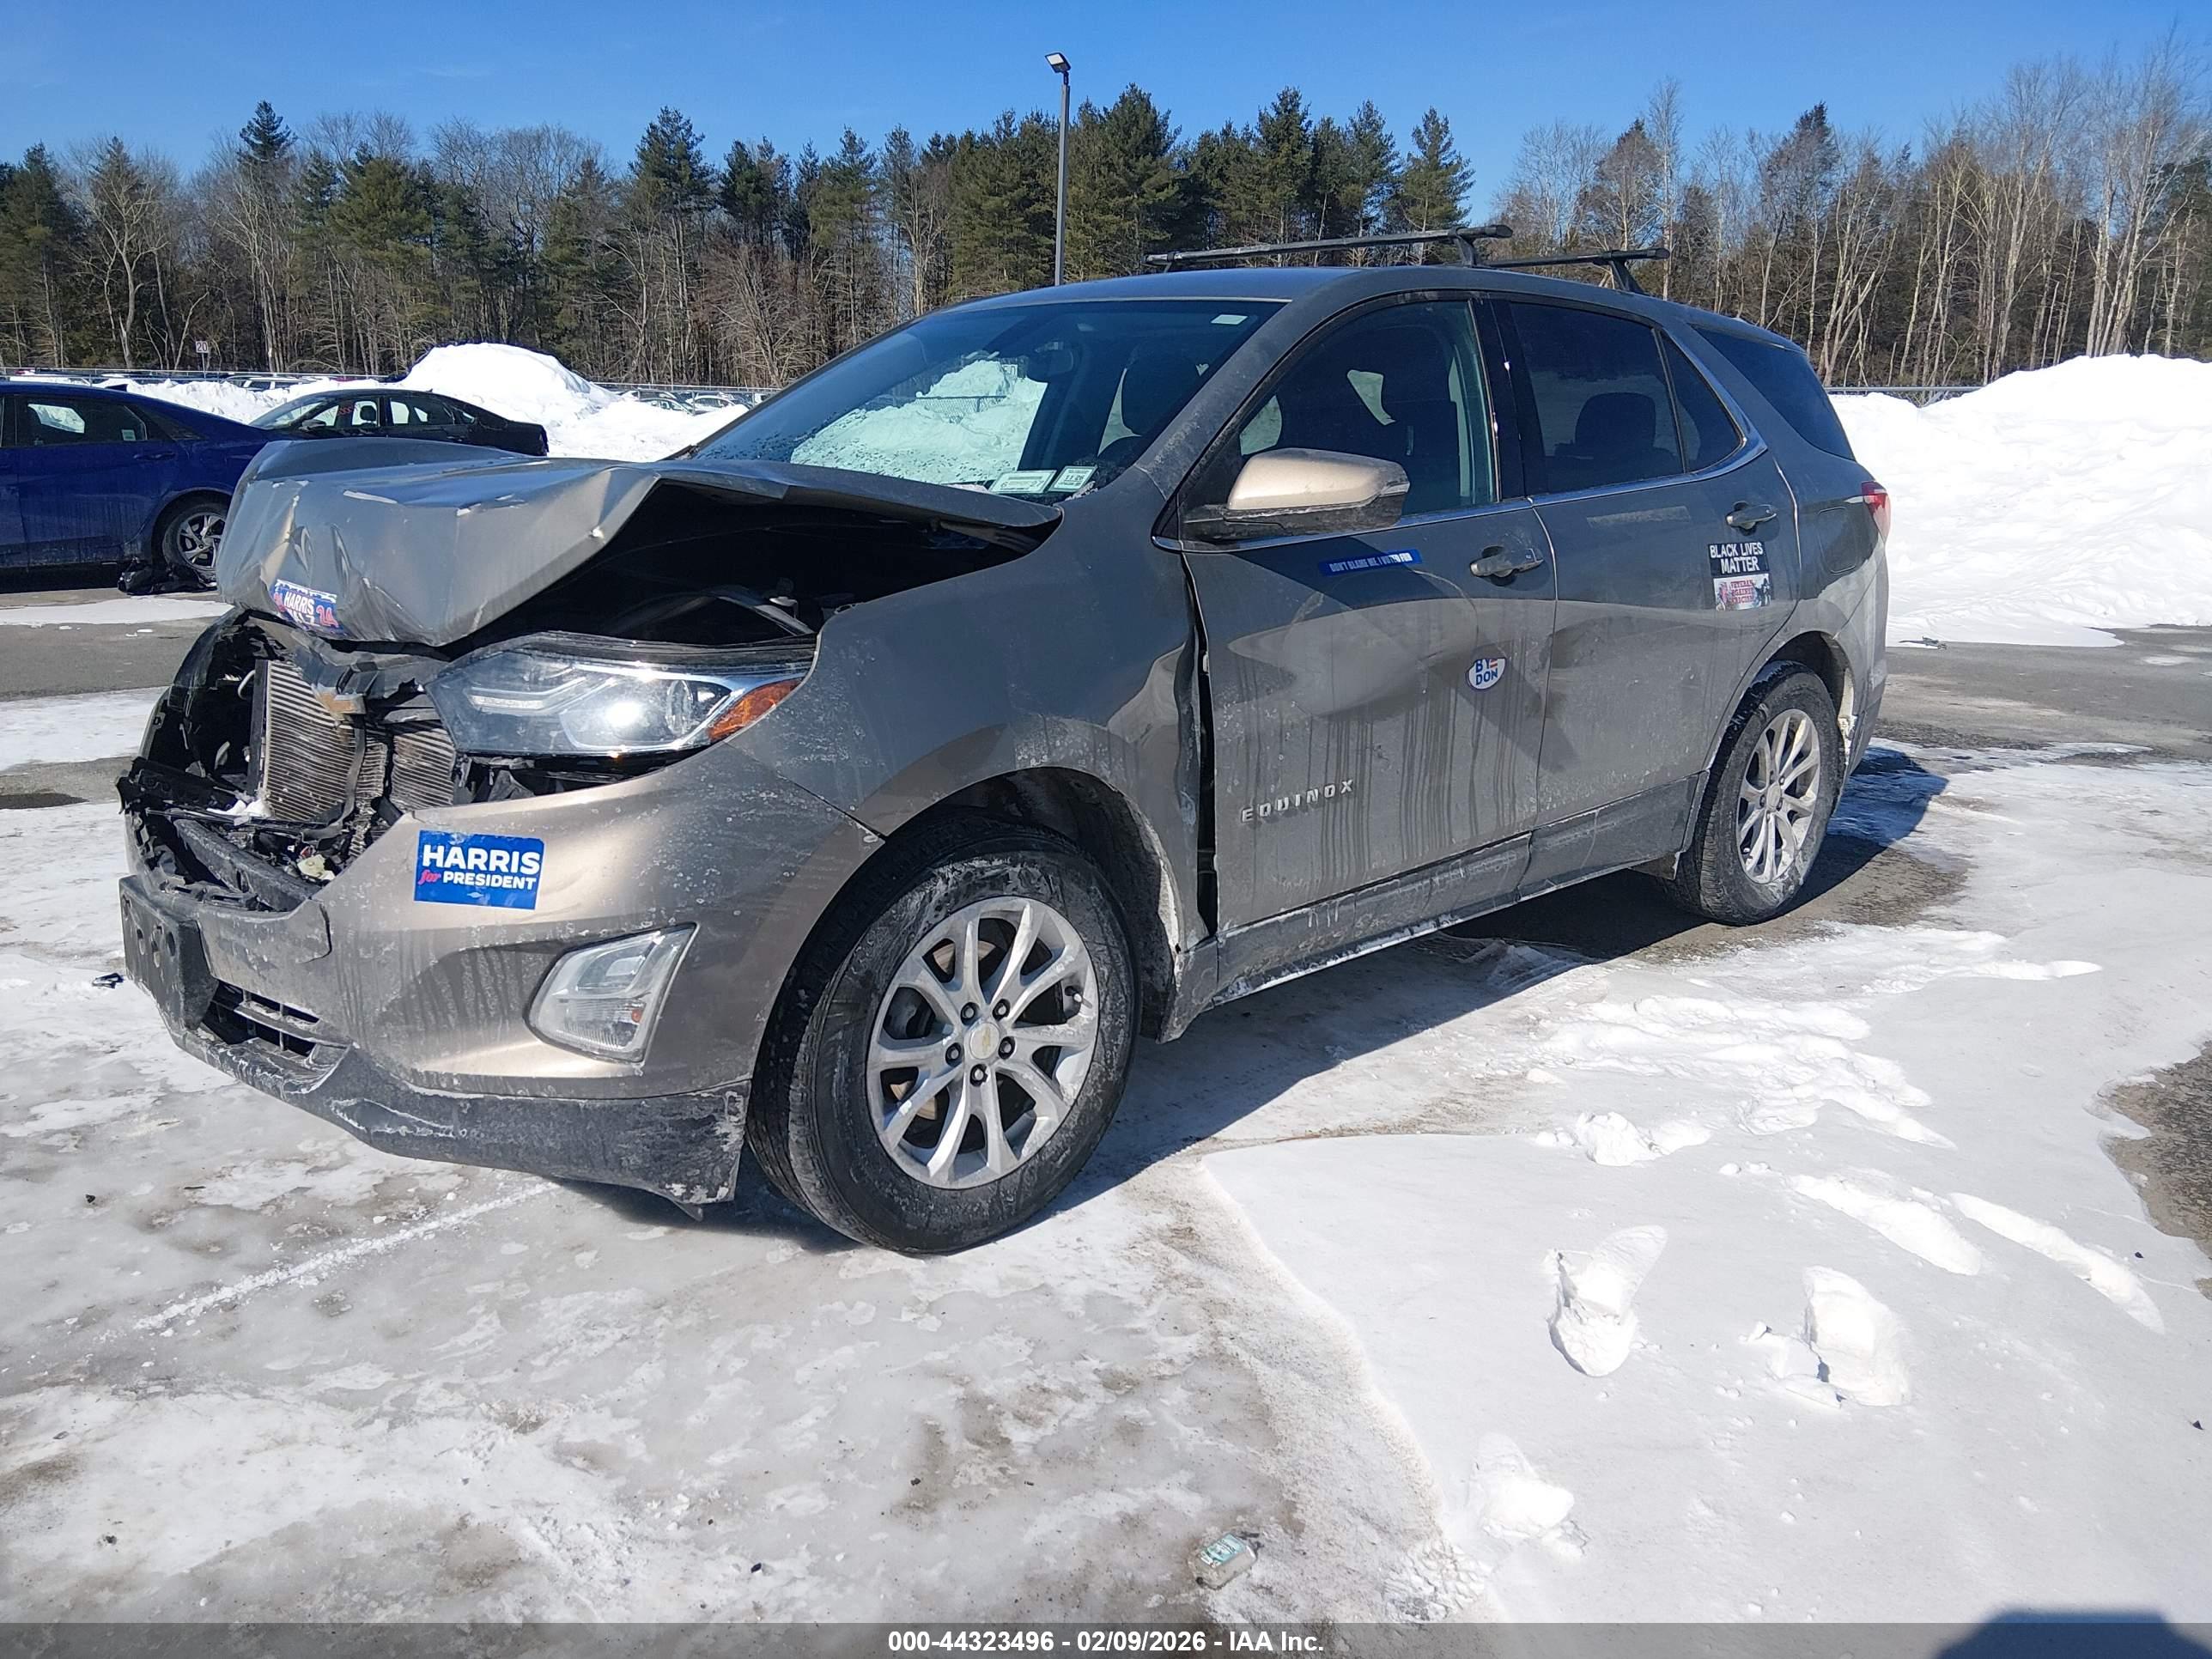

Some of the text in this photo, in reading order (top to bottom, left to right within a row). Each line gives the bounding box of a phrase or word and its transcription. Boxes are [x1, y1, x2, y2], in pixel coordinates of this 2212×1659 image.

[198, 343, 208, 352] 20
[1709, 542, 1764, 558] BLACK LIVES
[1720, 556, 1760, 574] MATTER
[283, 591, 315, 616] HARRIS
[315, 605, 340, 629] 24
[1475, 668, 1498, 686] DON
[1242, 779, 1354, 823] EQUINOX
[422, 844, 541, 875] HARRIS
[418, 869, 538, 890] for PRESIDENT
